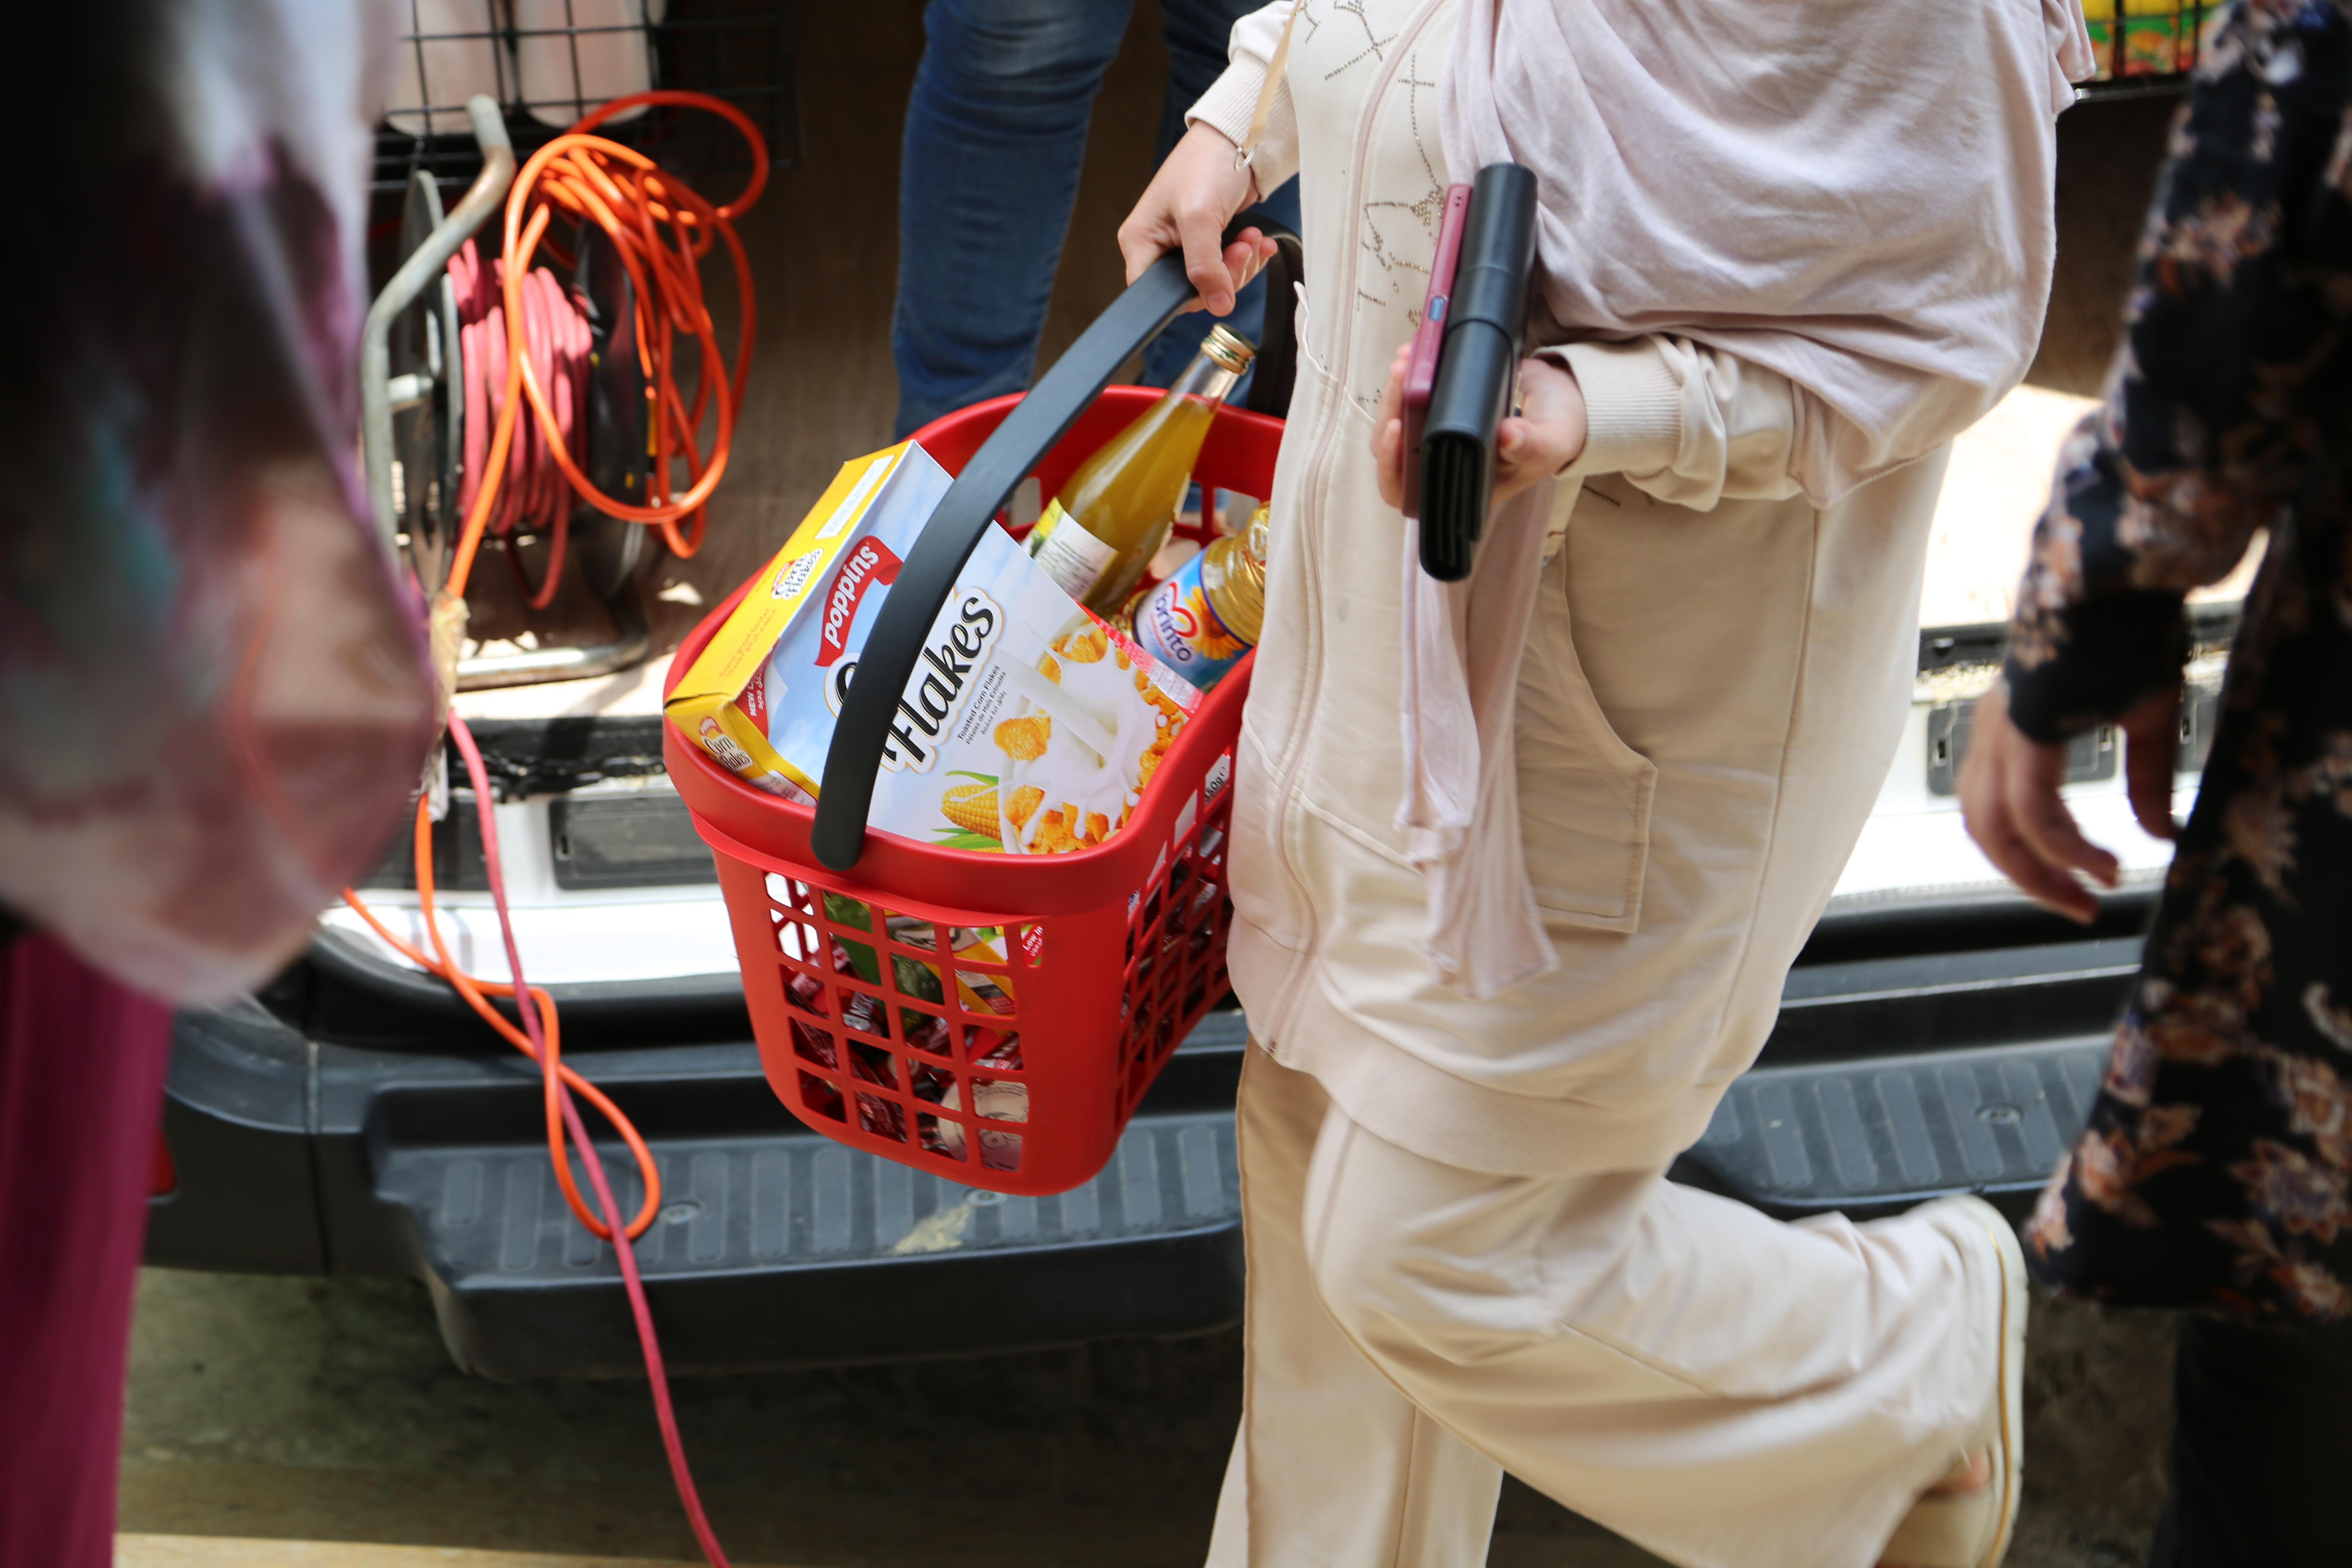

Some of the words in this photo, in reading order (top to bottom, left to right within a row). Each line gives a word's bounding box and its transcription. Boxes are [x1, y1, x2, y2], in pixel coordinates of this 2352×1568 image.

[824, 545, 880, 650] poppins
[746, 691, 757, 717] NEW
[882, 597, 993, 763] Flakes
[957, 708, 976, 740] Toasted
[973, 690, 987, 710] Corn
[982, 665, 1000, 690] Flakes
[965, 722, 981, 745] Pétales
[978, 713, 985, 723] de
[982, 698, 993, 713] Maïs
[990, 671, 1007, 699] Extrudés
[704, 735, 735, 754] Corn
[1022, 933, 1037, 951] Low
